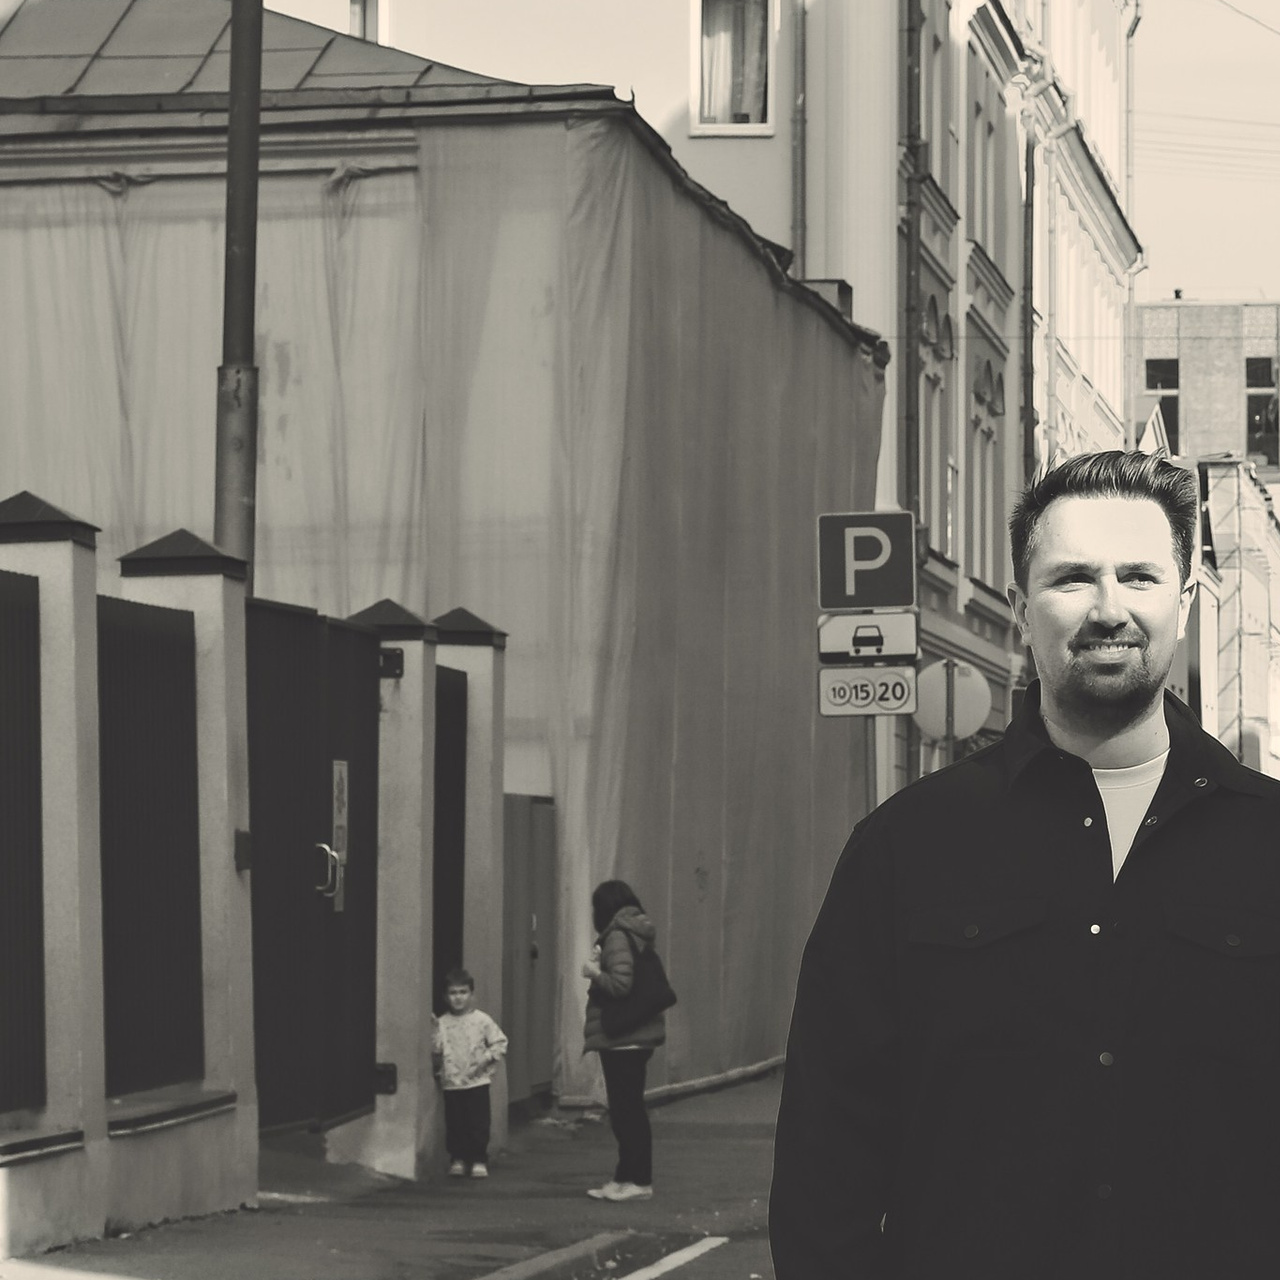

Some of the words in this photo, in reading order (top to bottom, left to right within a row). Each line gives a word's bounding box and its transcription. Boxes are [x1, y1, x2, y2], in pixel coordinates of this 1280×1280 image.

[844, 527, 892, 596] P
[831, 686, 847, 699] 10
[852, 683, 870, 701] 15
[878, 681, 905, 702] 20
